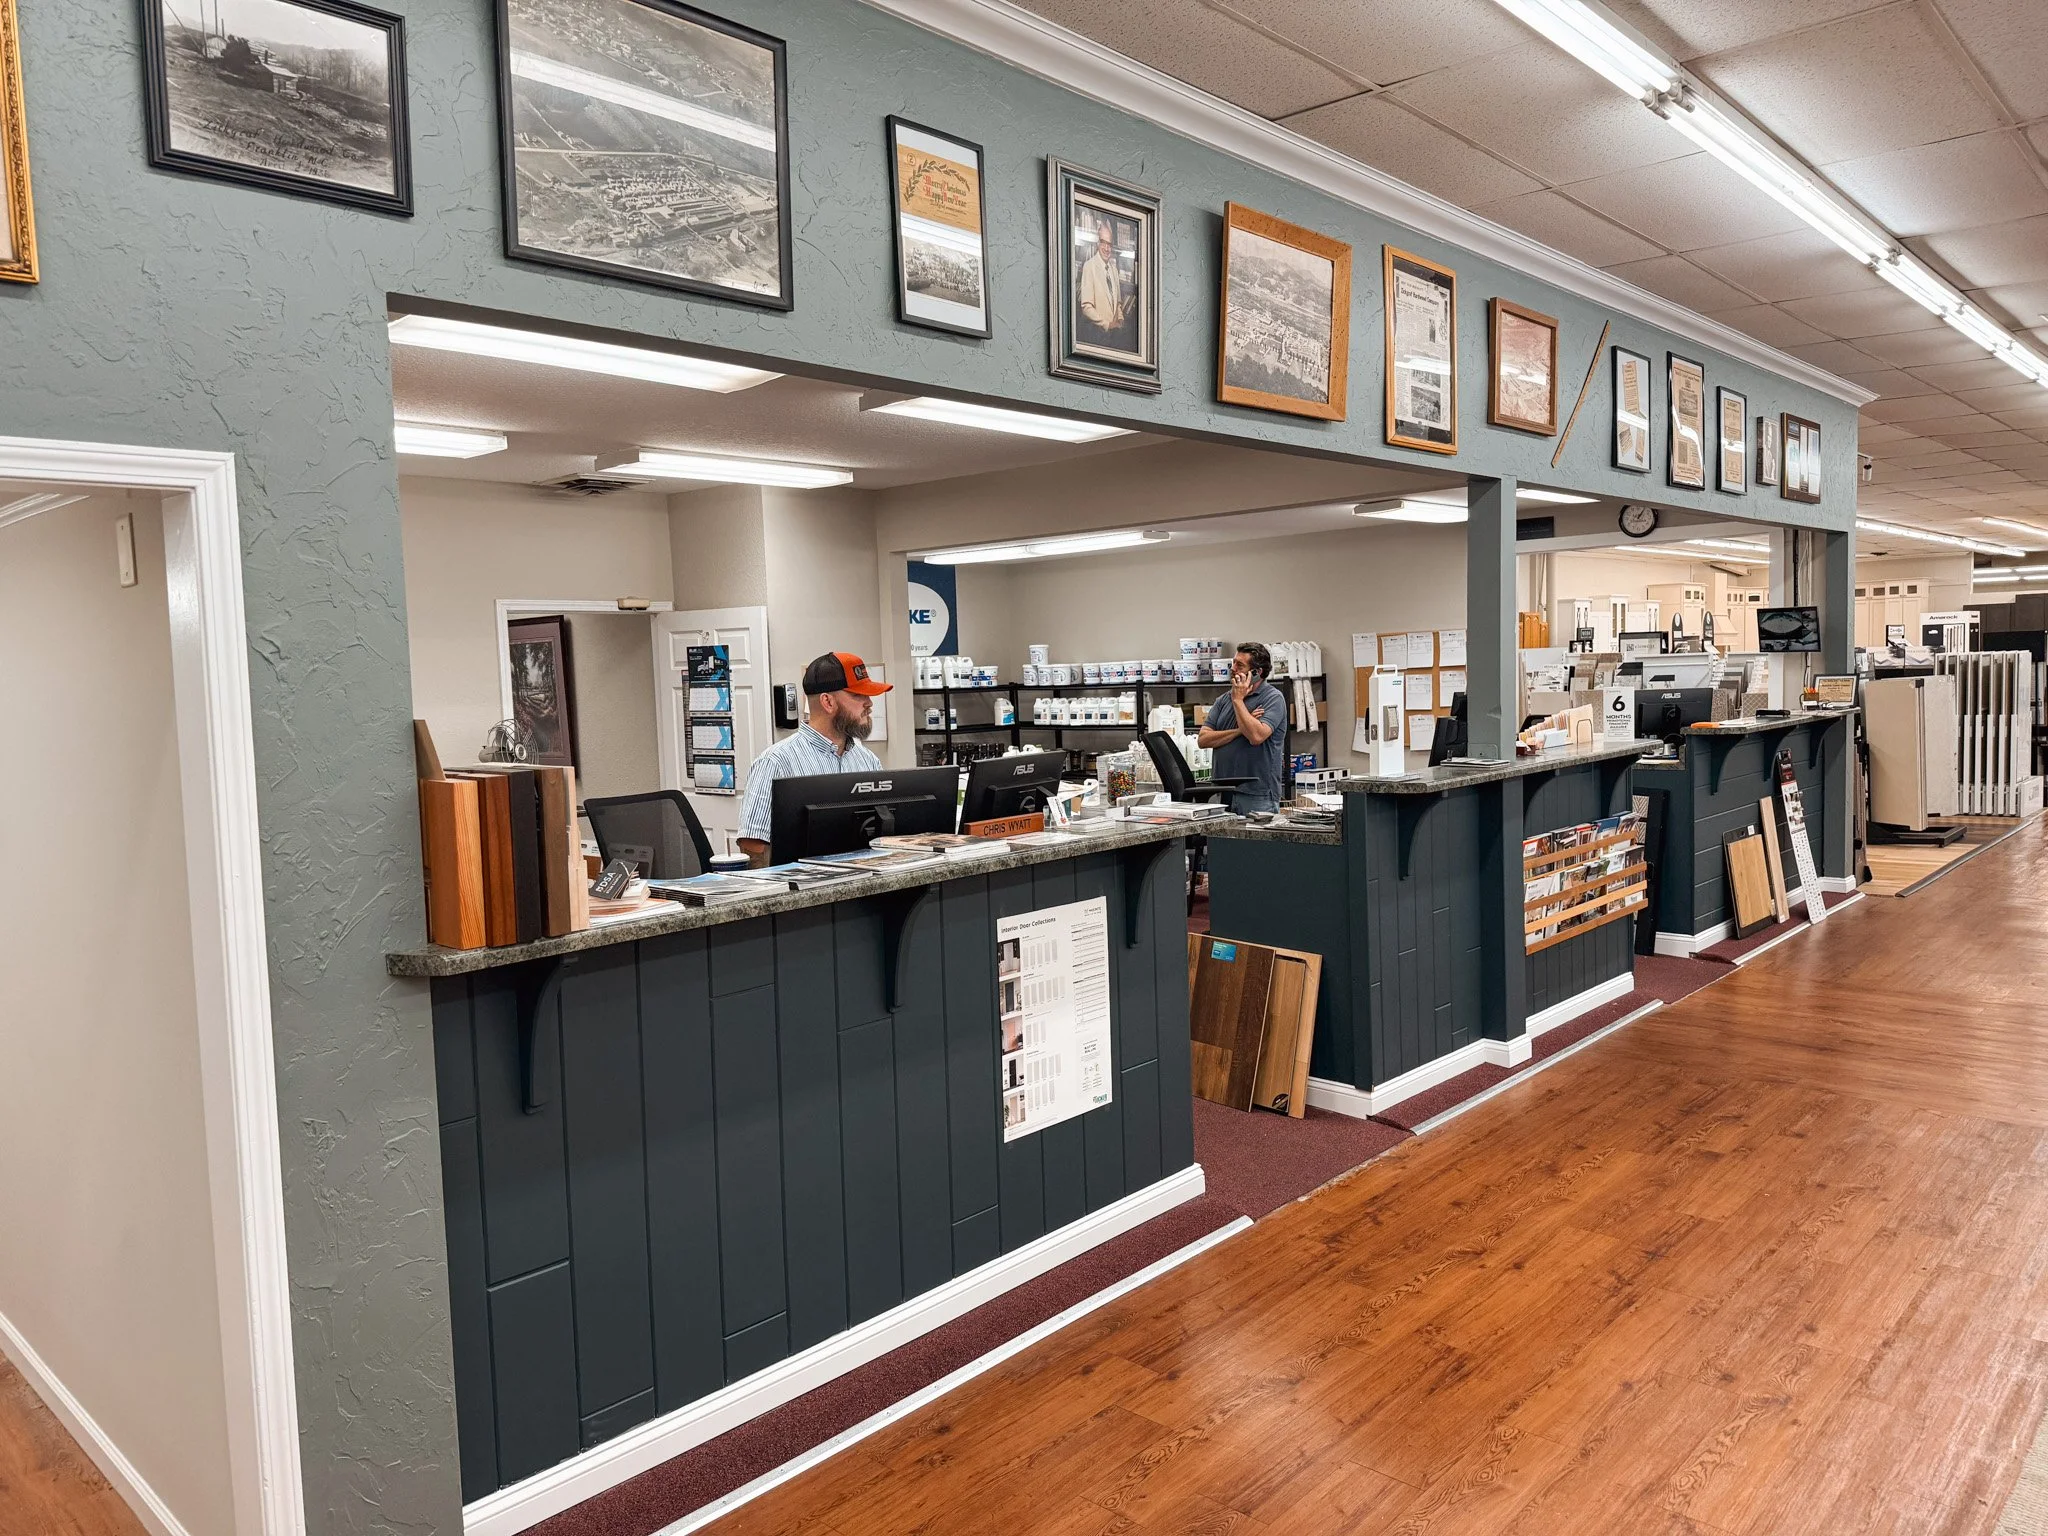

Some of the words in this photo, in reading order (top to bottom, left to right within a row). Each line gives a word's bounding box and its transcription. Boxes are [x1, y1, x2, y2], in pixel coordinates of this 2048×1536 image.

[1612, 695, 1626, 712] 6
[1660, 692, 1681, 700] ASUS
[1013, 763, 1035, 776] ASUS
[850, 780, 893, 794] ASUS
[983, 822, 1006, 836] CHRIS
[1007, 818, 1032, 832] WYATT
[1001, 926, 1019, 934] Interior
[1031, 917, 1056, 927] Collections
